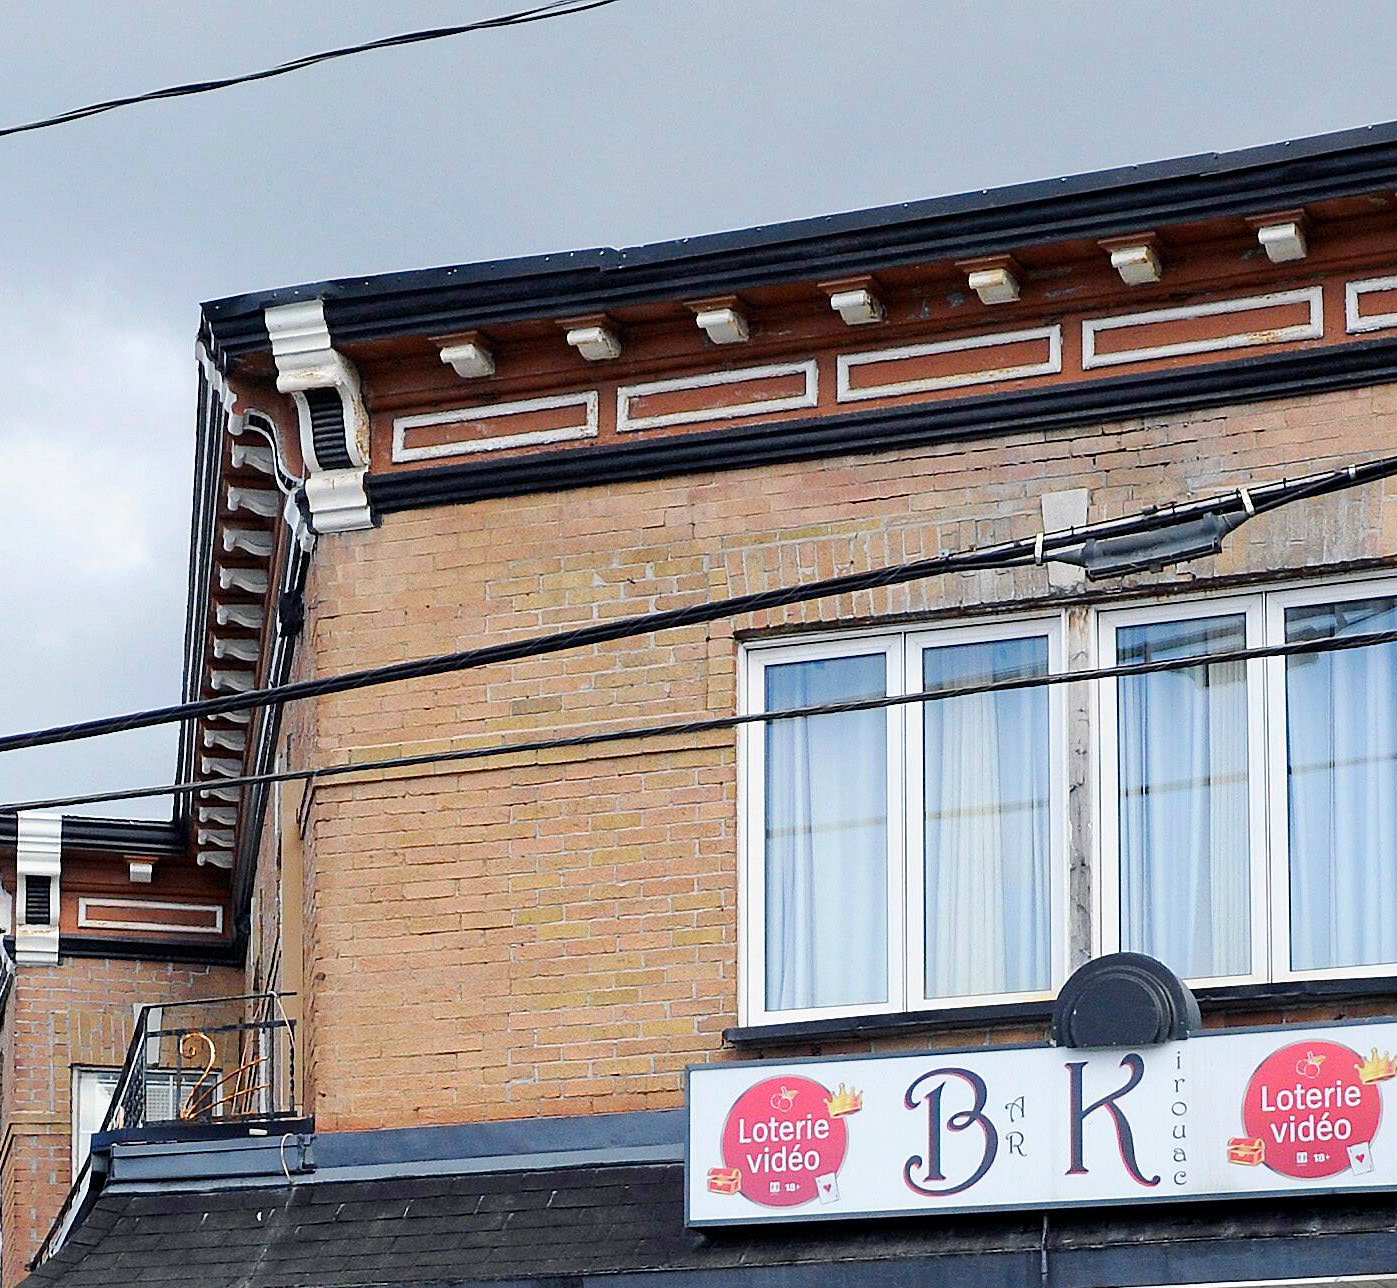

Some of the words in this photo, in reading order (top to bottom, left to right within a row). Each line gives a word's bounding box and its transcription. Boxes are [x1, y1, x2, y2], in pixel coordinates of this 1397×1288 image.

[1261, 1080, 1362, 1112] Loterie
[739, 1113, 830, 1143] Loterie
[1270, 1112, 1351, 1143] vidéo
[746, 1144, 820, 1173] vidéo
[1313, 1153, 1331, 1163] 18+
